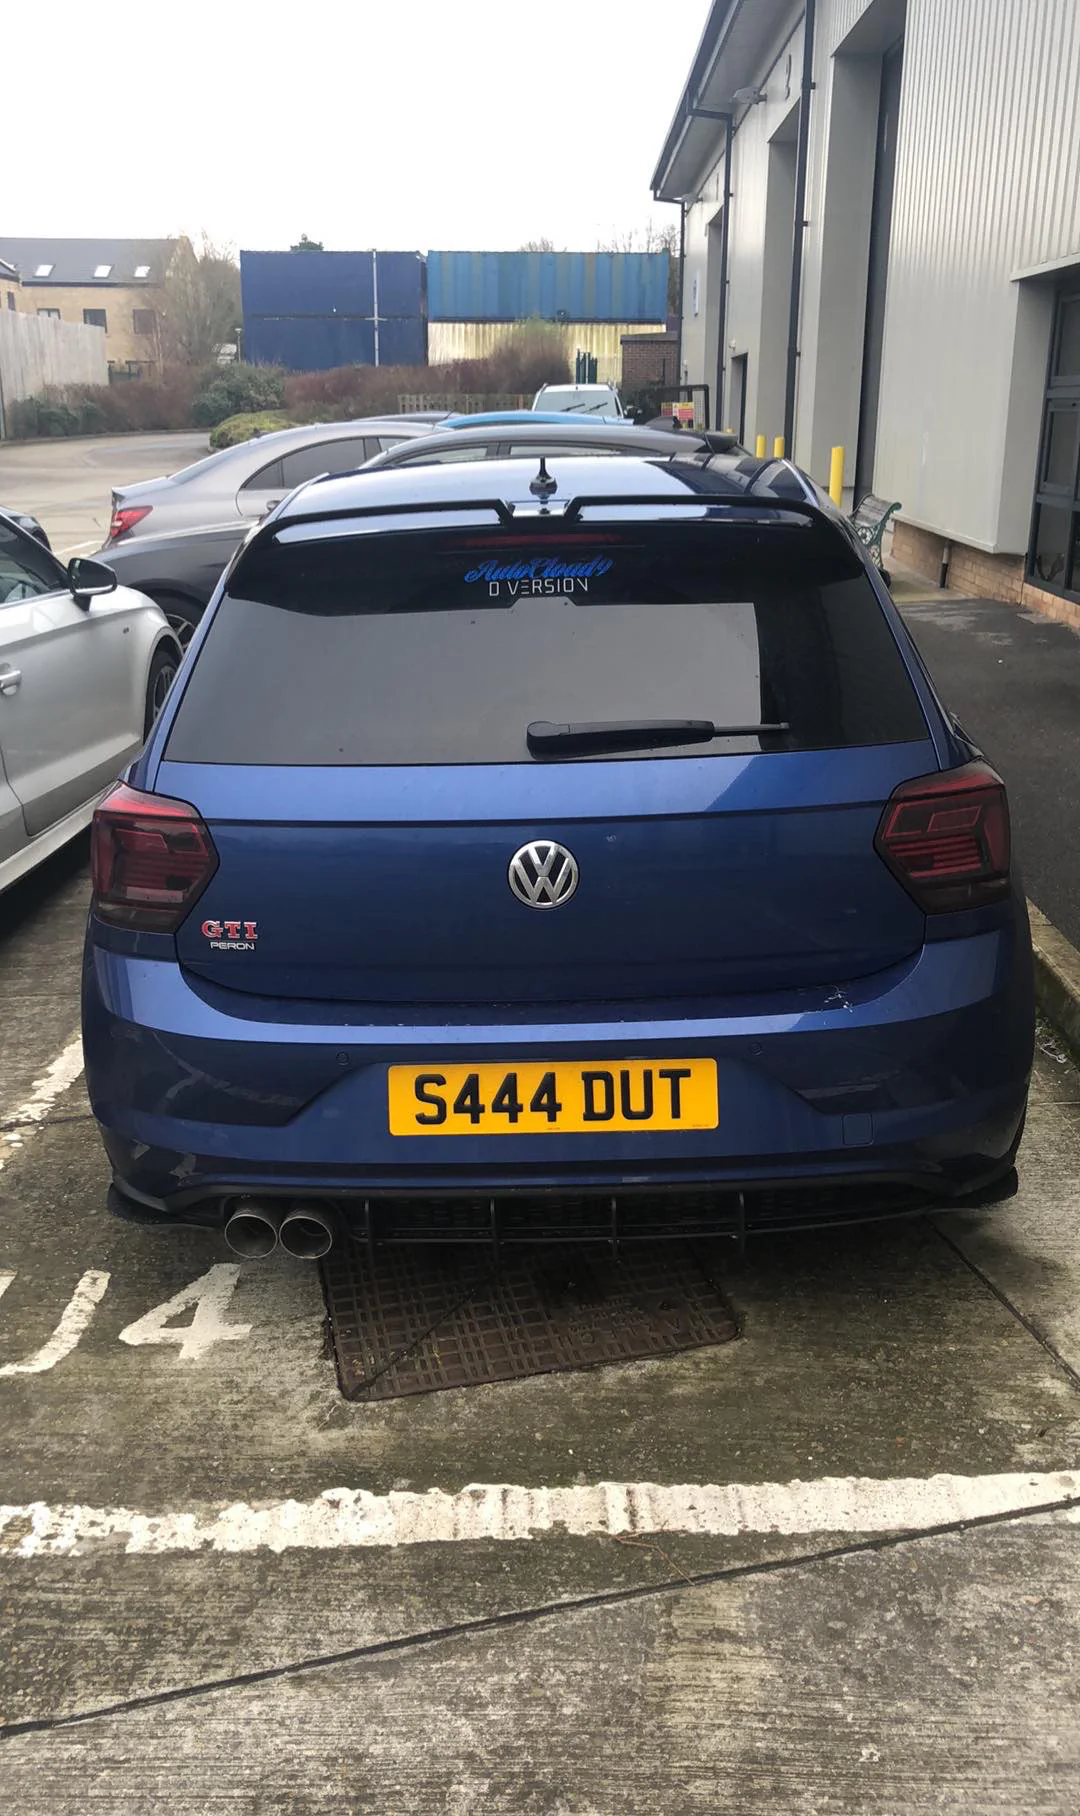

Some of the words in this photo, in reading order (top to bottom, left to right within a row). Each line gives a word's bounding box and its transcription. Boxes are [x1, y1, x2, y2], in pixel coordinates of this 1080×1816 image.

[201, 920, 259, 940] GTI
[209, 941, 255, 951] PERON
[413, 1072, 562, 1125] S444
[581, 1068, 692, 1122] DUT
